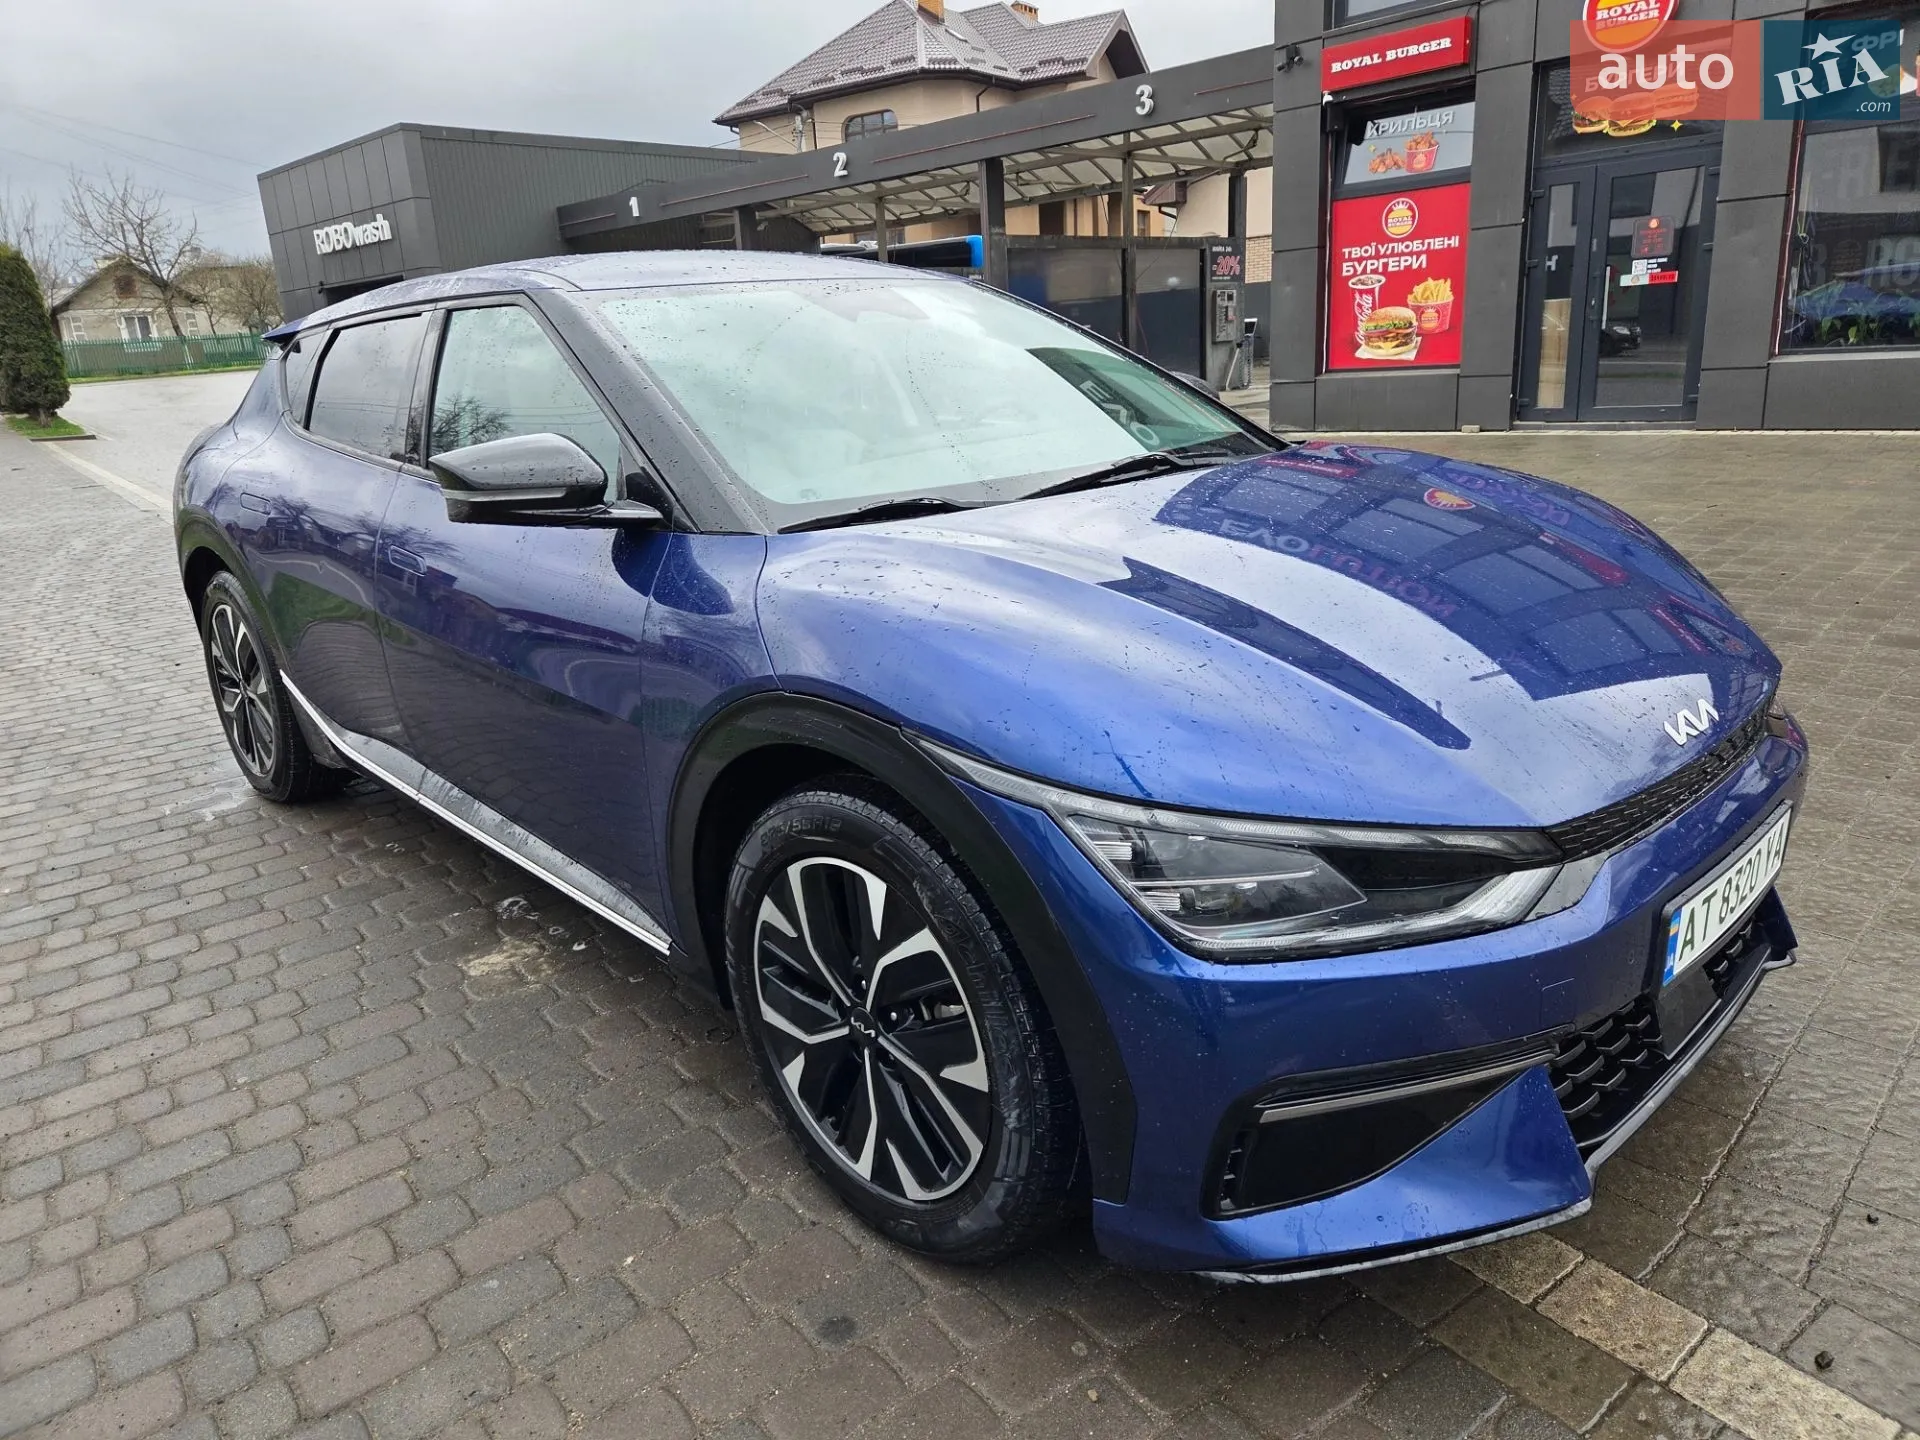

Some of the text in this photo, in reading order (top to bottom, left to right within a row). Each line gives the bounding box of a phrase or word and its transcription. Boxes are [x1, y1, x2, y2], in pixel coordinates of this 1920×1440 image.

[1595, 11, 1660, 30] BURGER
[1597, 0, 1660, 20] ROYAL
[1331, 37, 1452, 73] ROYAL BURGER
[1135, 84, 1154, 115] 3
[832, 152, 848, 176] 2
[629, 196, 640, 216] 1
[1342, 235, 1459, 258] ТВОЇ УЛЮБЛЕНІ
[1342, 254, 1427, 276] БУРГЕРИ
[1679, 822, 1784, 961] AT 8320 YA
